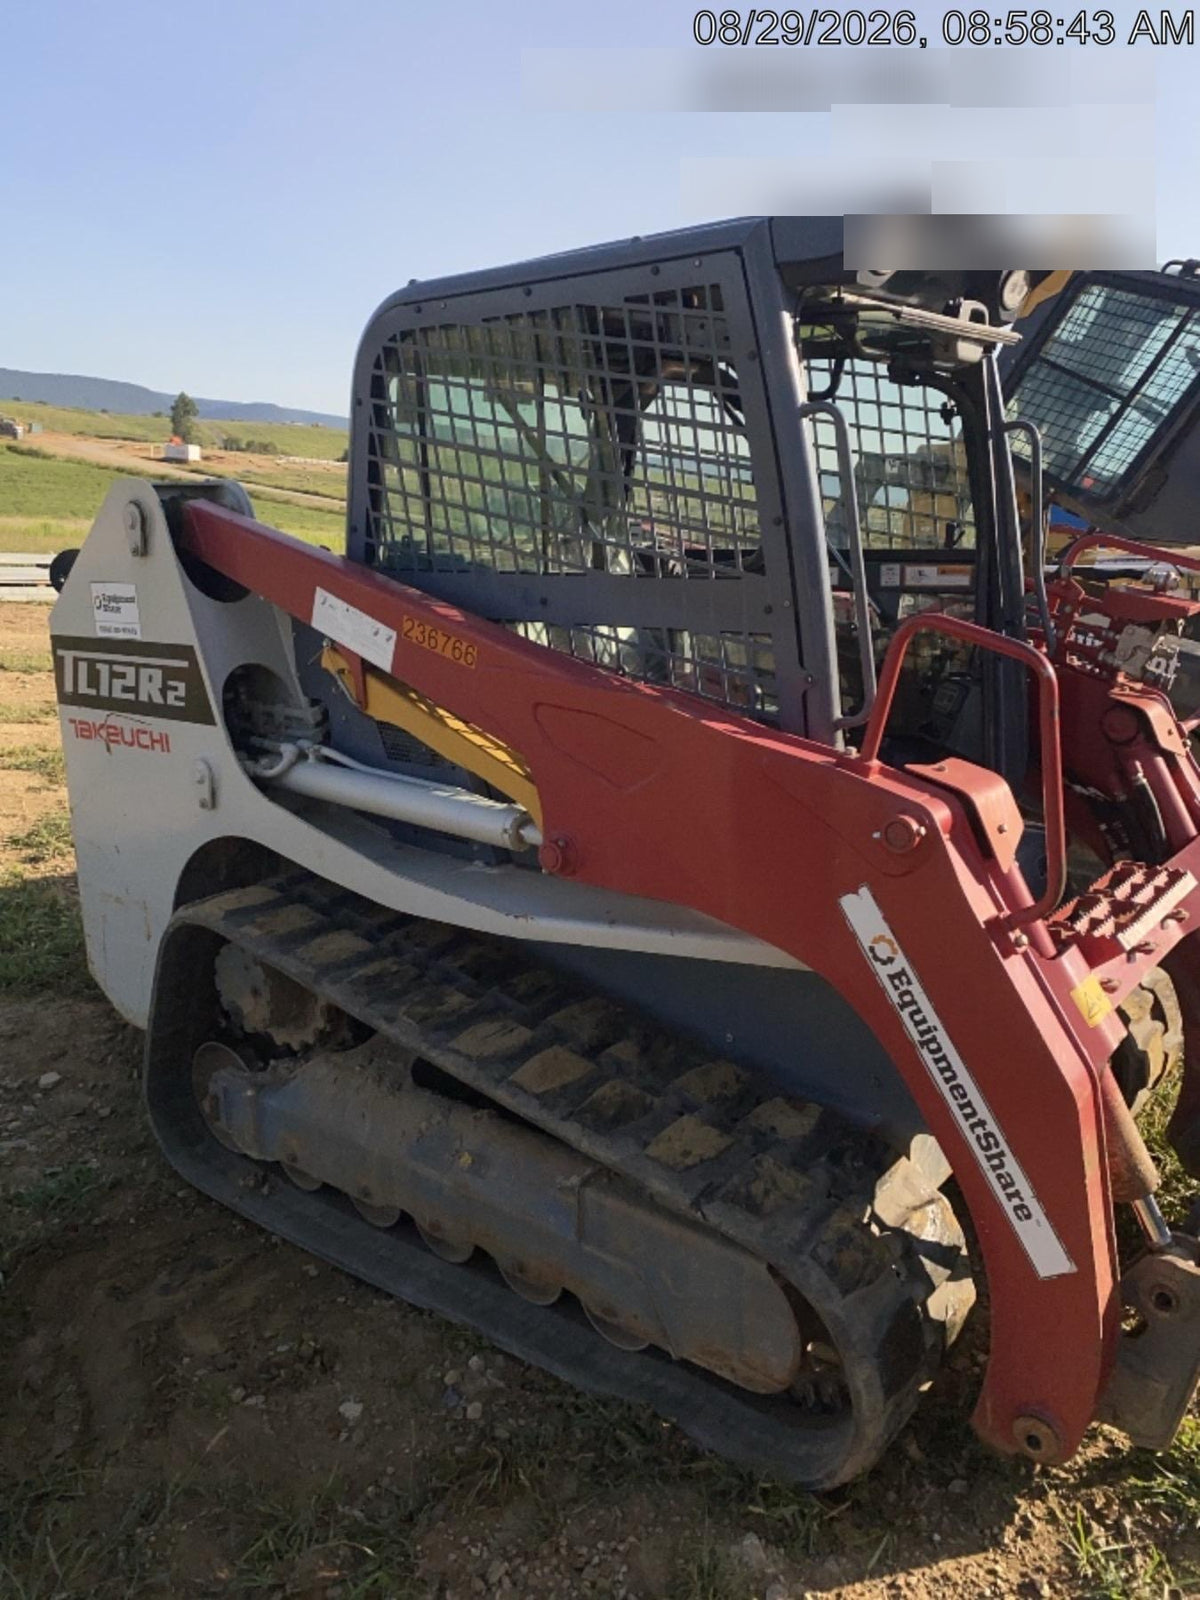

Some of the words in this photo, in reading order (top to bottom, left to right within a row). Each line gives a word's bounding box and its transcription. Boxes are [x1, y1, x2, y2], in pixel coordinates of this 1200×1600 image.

[403, 617, 477, 667] 236766
[56, 649, 189, 707] TL12R2
[887, 968, 1033, 1223] EquipmentShare
